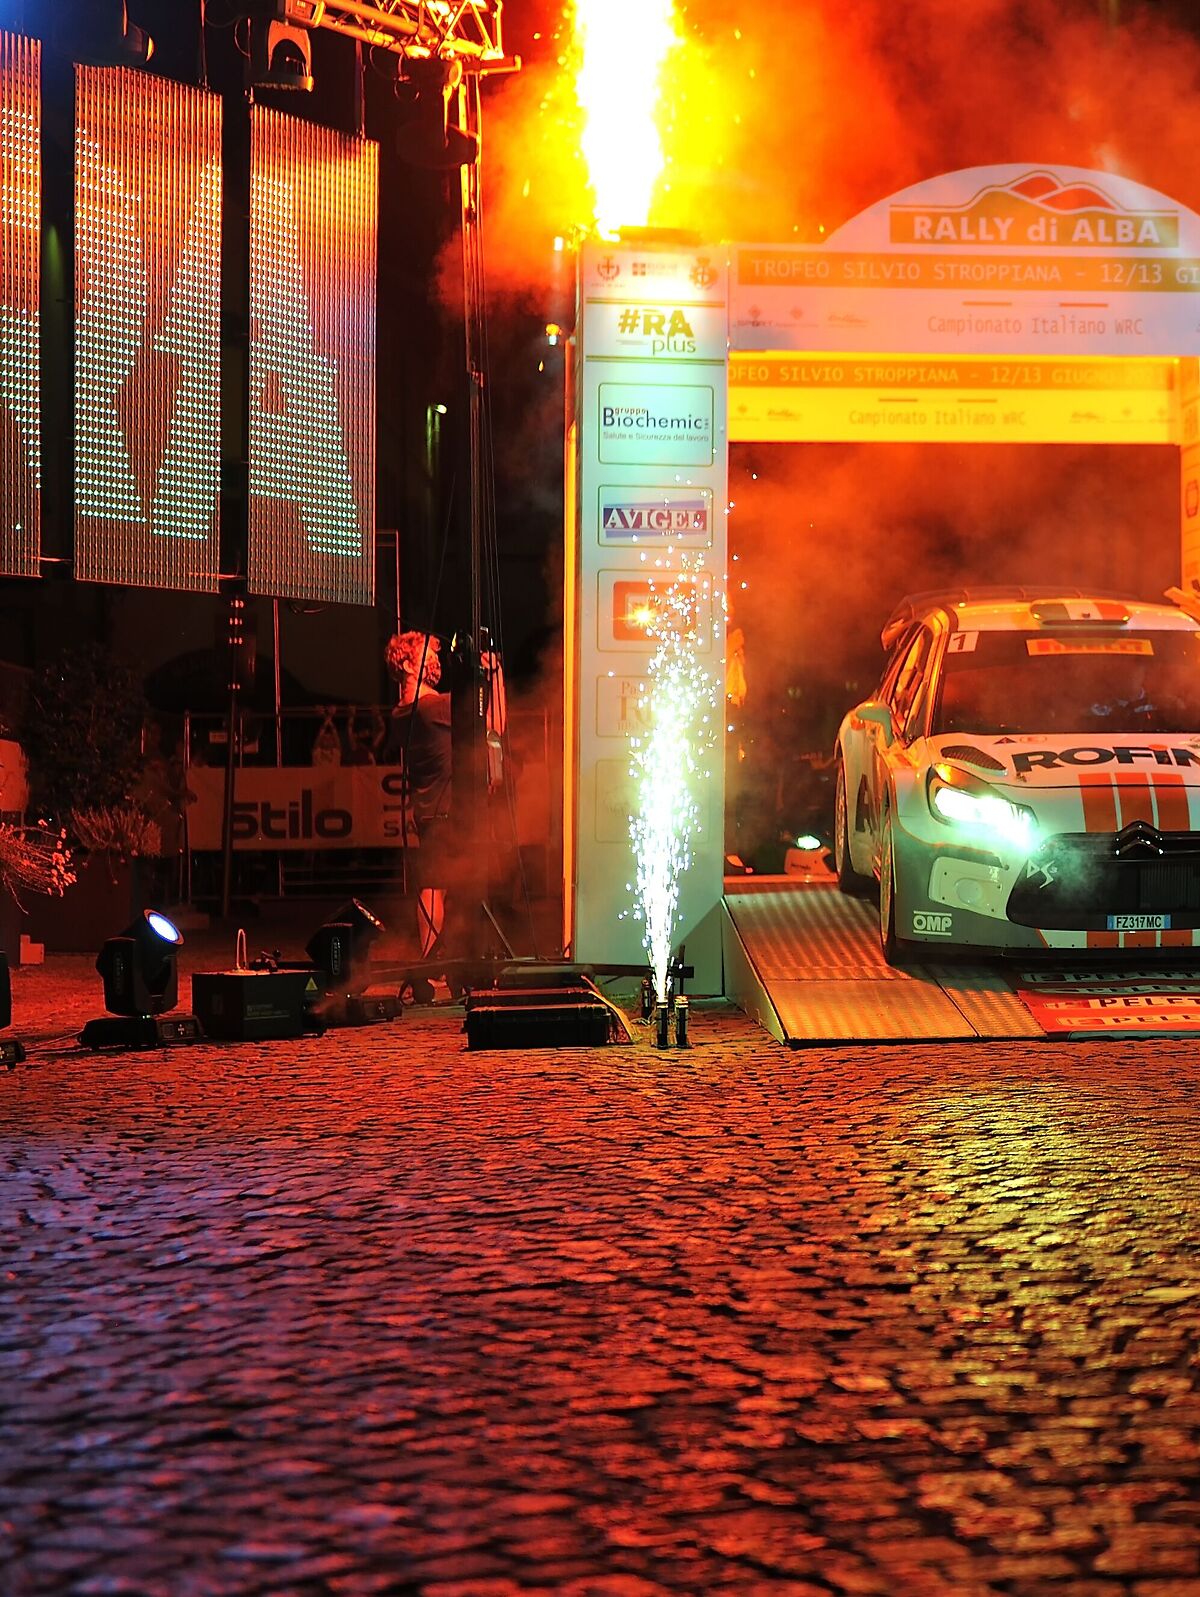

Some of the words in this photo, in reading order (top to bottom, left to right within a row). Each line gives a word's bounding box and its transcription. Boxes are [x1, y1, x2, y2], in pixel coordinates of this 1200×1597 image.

[913, 215, 1016, 241] RALLY
[1027, 216, 1058, 242] di
[1072, 218, 1160, 243] ALBA
[752, 259, 830, 279] TROFEO
[843, 261, 921, 280] SILVIO
[934, 263, 1061, 282] STROPPIANA
[1101, 263, 1163, 285] 12/13
[928, 315, 1022, 336] Campionato
[1031, 315, 1106, 335] Italiano
[1115, 318, 1143, 335] WRC
[652, 334, 697, 356] plus
[779, 366, 844, 382] SILVIO
[854, 367, 959, 383] STROPPIANA
[990, 366, 1042, 385] 12/13
[614, 407, 647, 416] gruppo
[849, 409, 928, 427] Campionato
[934, 408, 996, 425] Italiano
[953, 634, 967, 650] 1
[912, 914, 952, 932] OMP
[1116, 916, 1162, 928] FZ317MC
